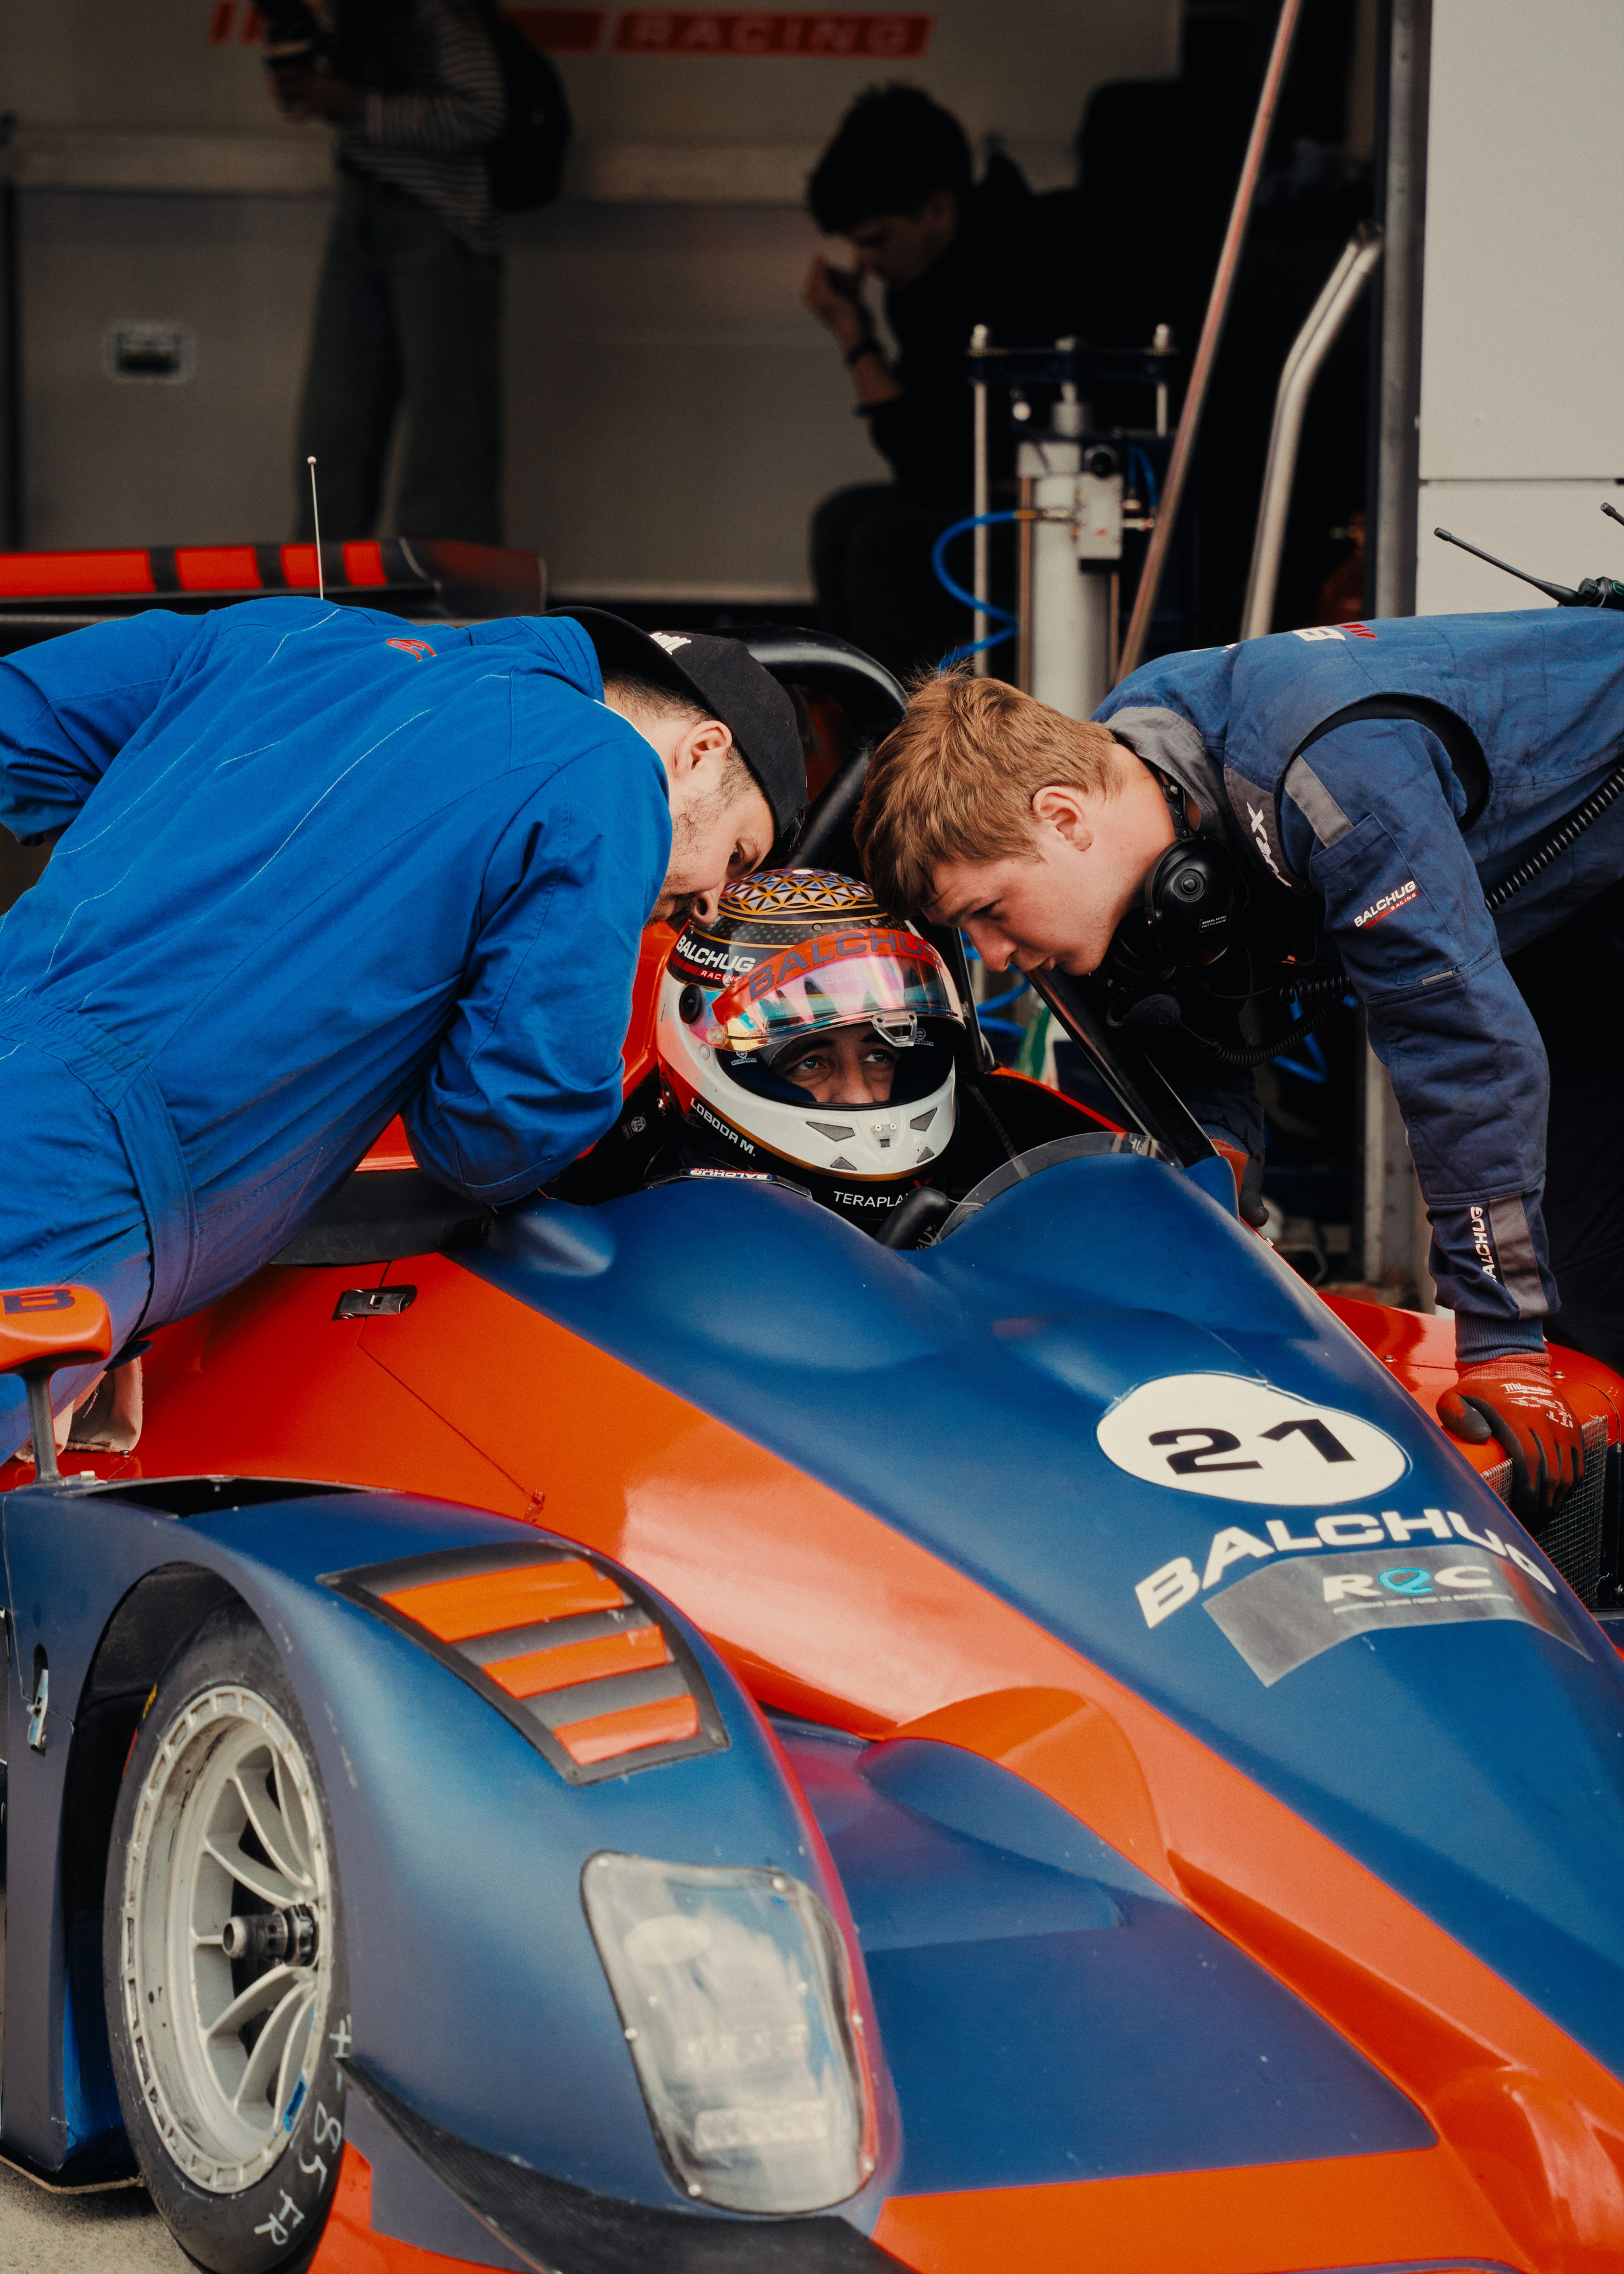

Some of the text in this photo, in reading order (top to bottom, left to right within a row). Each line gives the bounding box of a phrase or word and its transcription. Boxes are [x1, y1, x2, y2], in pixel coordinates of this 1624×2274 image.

[628, 13, 912, 54] RACING
[1354, 881, 1416, 928] BALCHUG
[1391, 893, 1417, 910] RACING
[676, 935, 756, 972] BALCHUG
[749, 931, 943, 1002] BALCHUG
[690, 1097, 756, 1157] LOBODA M.
[834, 1190, 908, 1208] TERAPLA
[1470, 1206, 1498, 1284] ALCHUG
[3, 1290, 75, 1315] B
[1499, 1383, 1553, 1394] Milwaukee
[1148, 1419, 1357, 1475] 21
[1134, 1508, 1557, 1629] BALCHUG
[254, 2189, 305, 2245] FR
